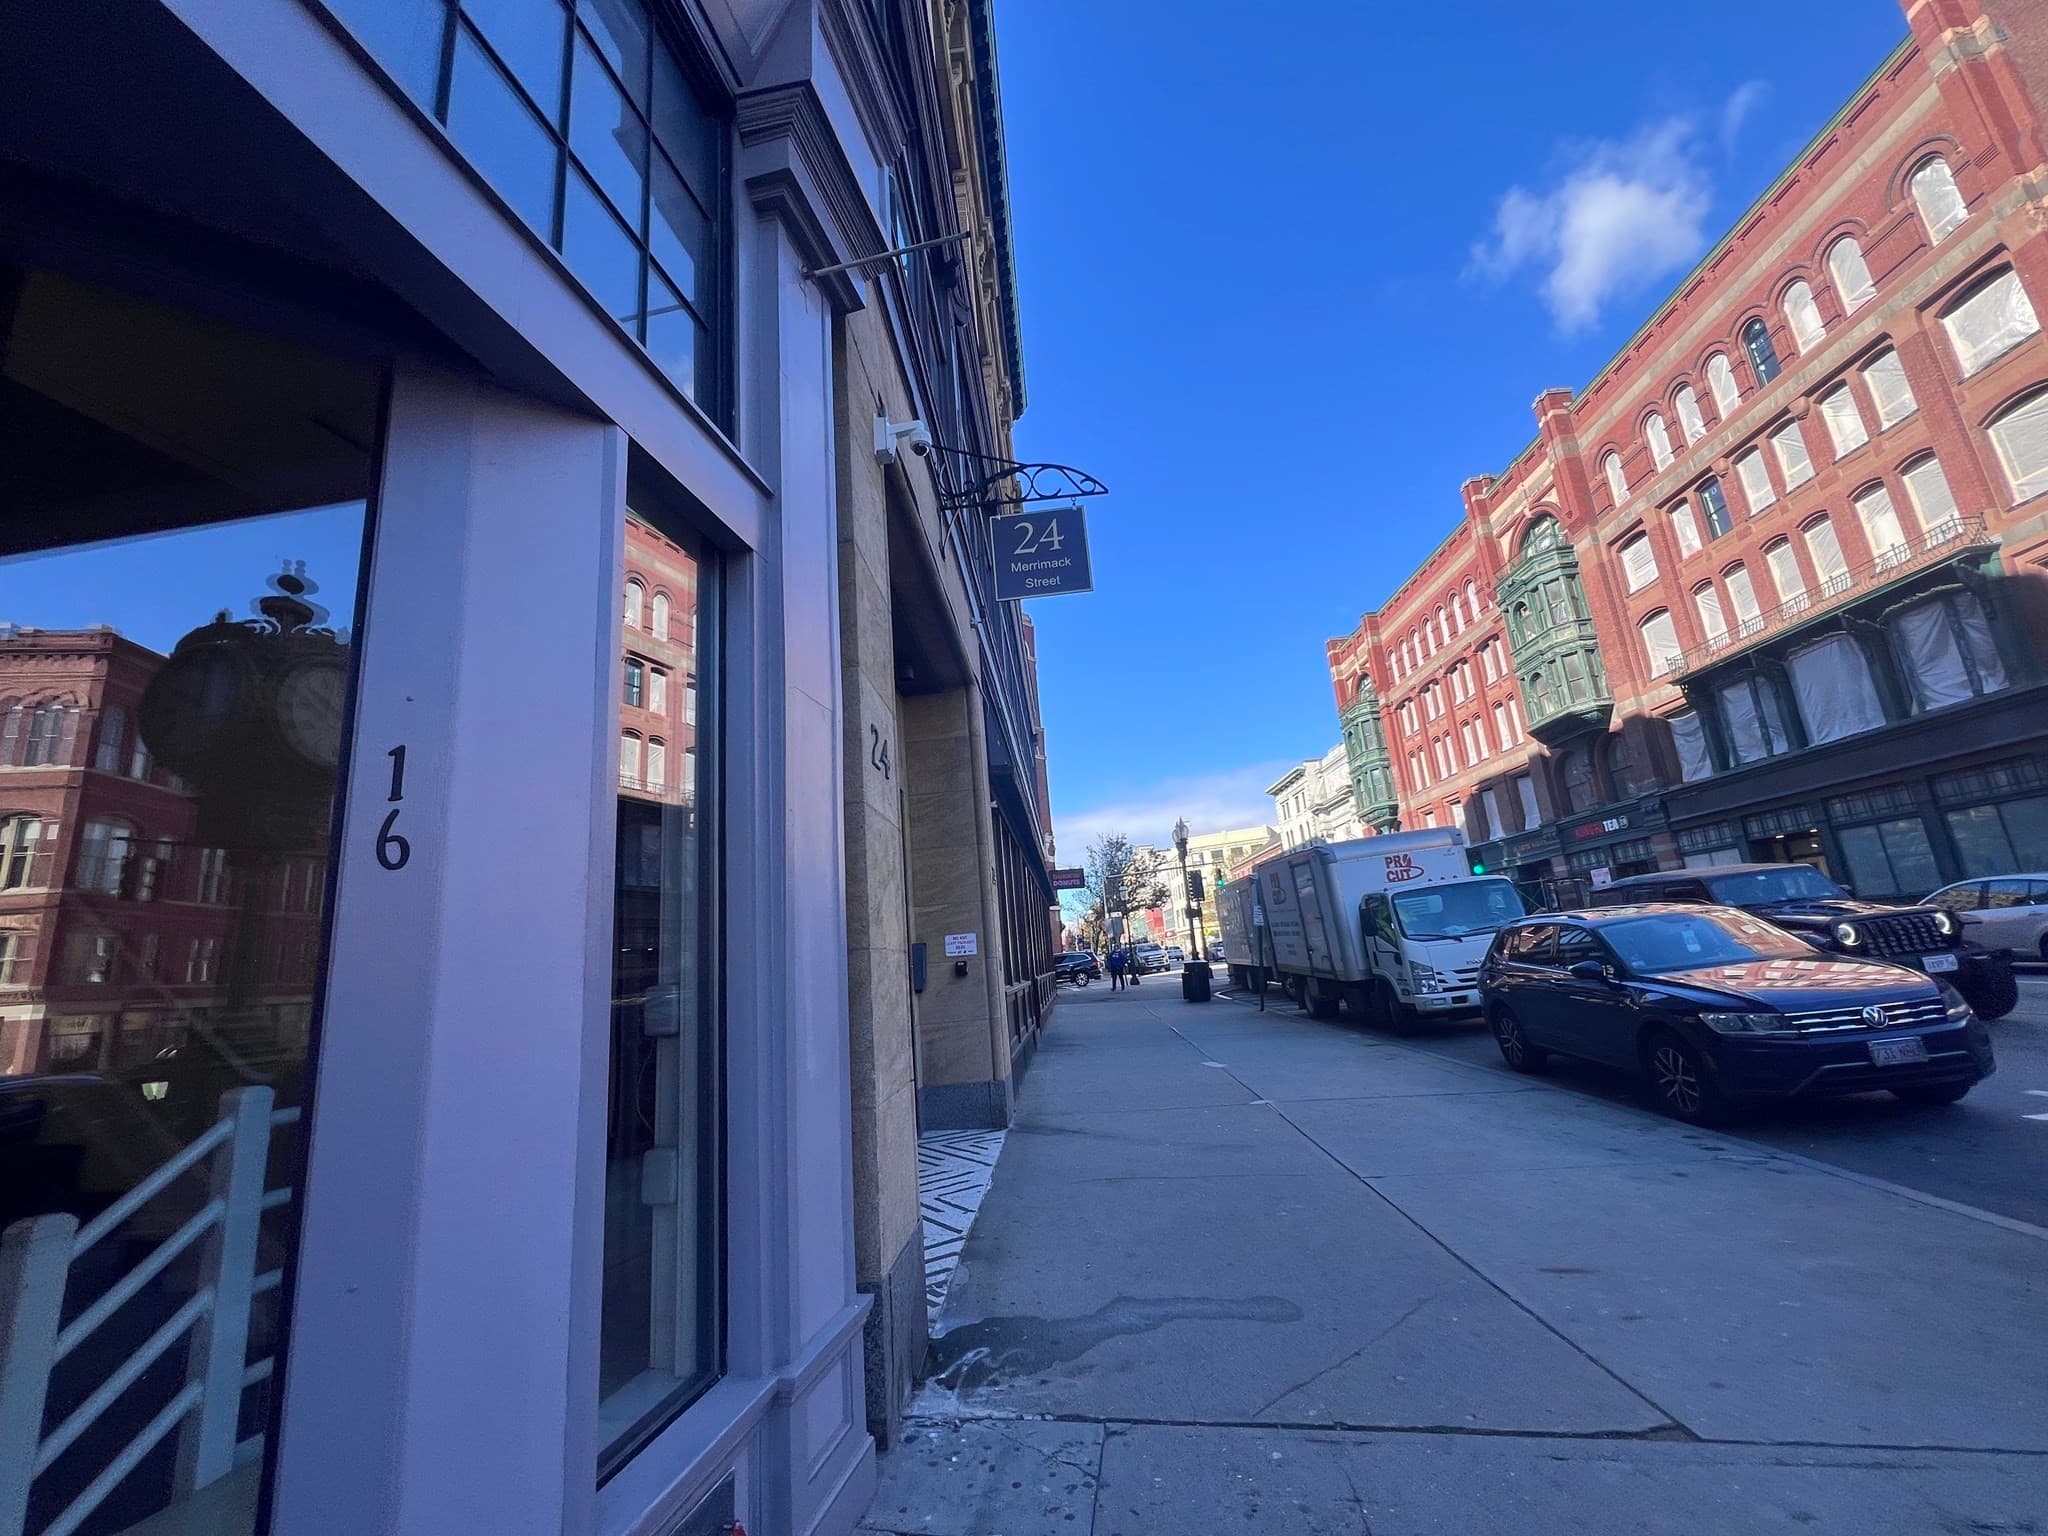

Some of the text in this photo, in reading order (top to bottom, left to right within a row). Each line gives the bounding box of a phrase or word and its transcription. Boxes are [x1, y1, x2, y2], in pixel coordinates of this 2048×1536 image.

[1014, 518, 1065, 555] 24
[1011, 557, 1072, 573] Merrimack
[1025, 575, 1061, 589] Street
[870, 723, 891, 780] 24
[1387, 868, 1412, 882] CUT
